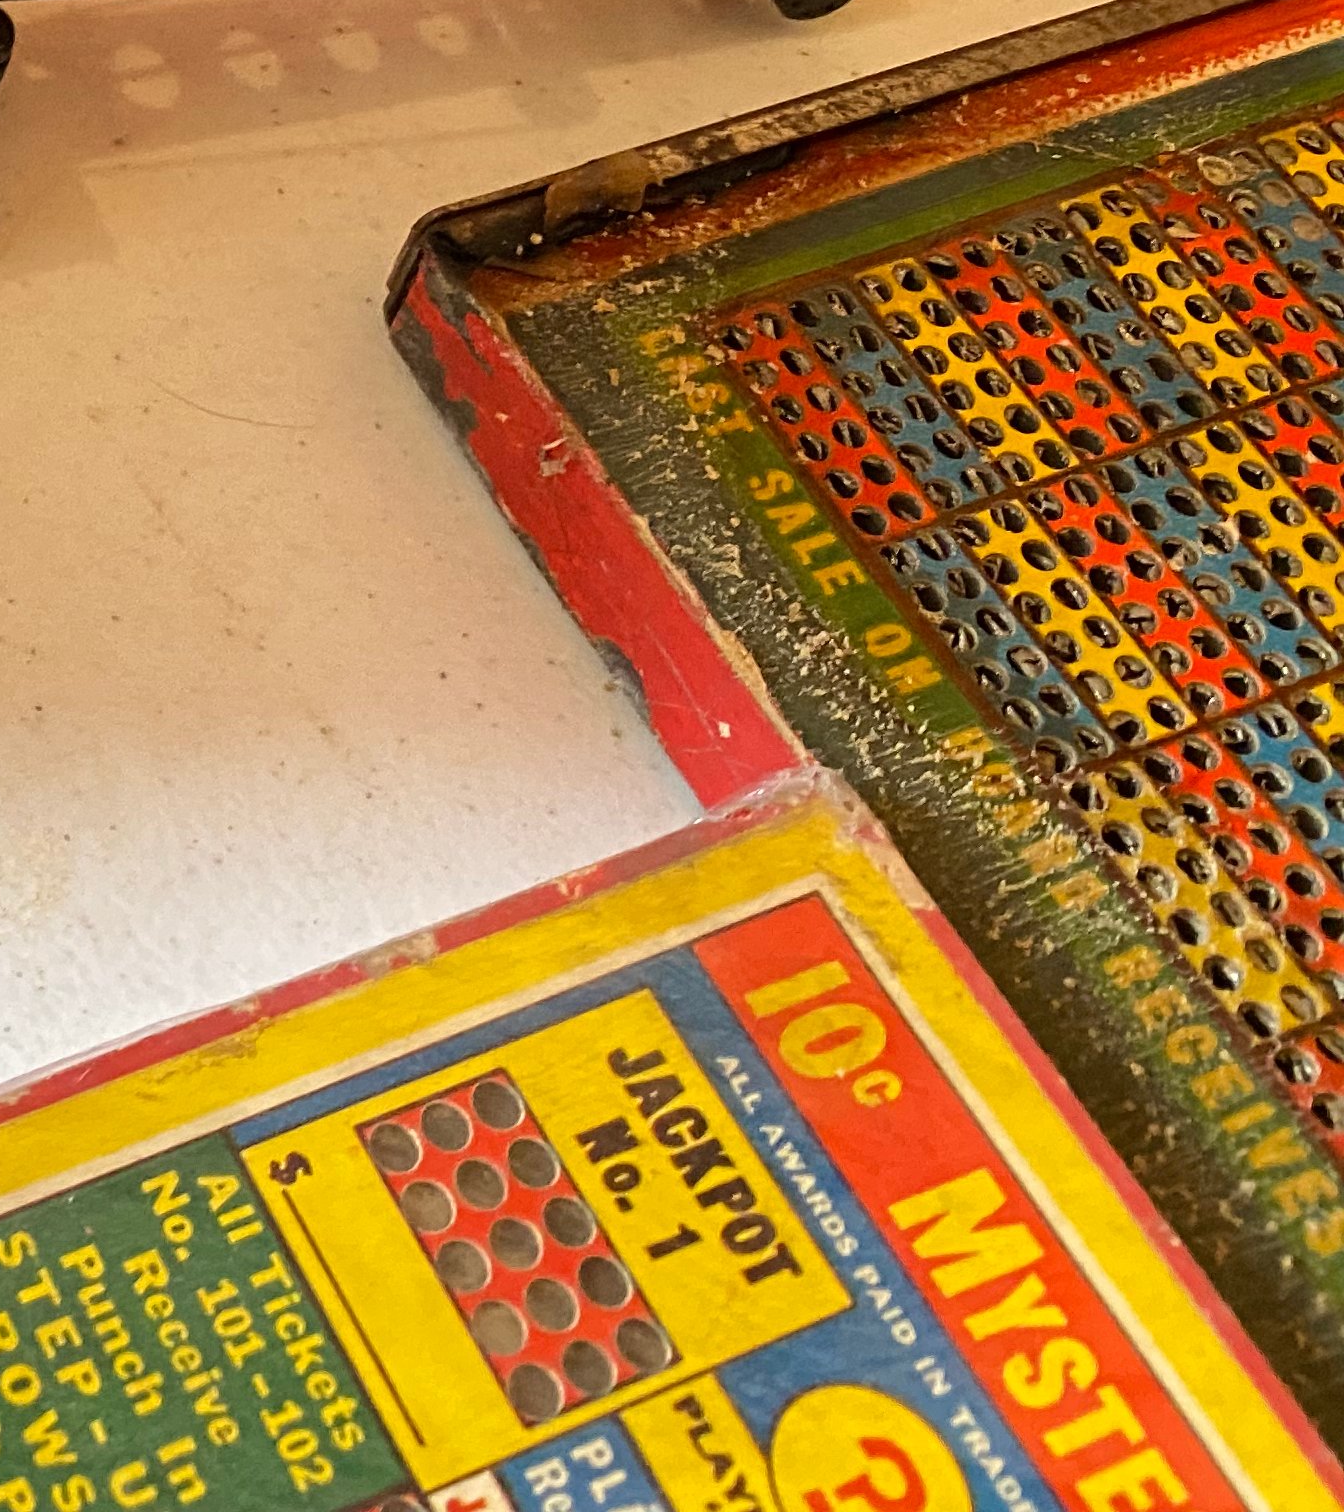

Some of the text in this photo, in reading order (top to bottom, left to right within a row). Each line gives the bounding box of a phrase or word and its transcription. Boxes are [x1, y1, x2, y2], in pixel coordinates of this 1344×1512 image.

[749, 468, 868, 597] SALE
[864, 622, 942, 694] ON
[140, 1169, 194, 1263] No.
[575, 1115, 703, 1260] No. 1
[607, 1047, 803, 1286] JACKPOT
[716, 1054, 762, 1115] ALL
[759, 1123, 859, 1257] AWARDS
[853, 1263, 917, 1346] PAID
[913, 1354, 952, 1397] IN
[59, 1243, 207, 1504] Punch In
[122, 1248, 240, 1446] Receive
[197, 1174, 366, 1451] All Tickets
[569, 1436, 646, 1512] PL
[673, 1393, 762, 1512] PLAY
